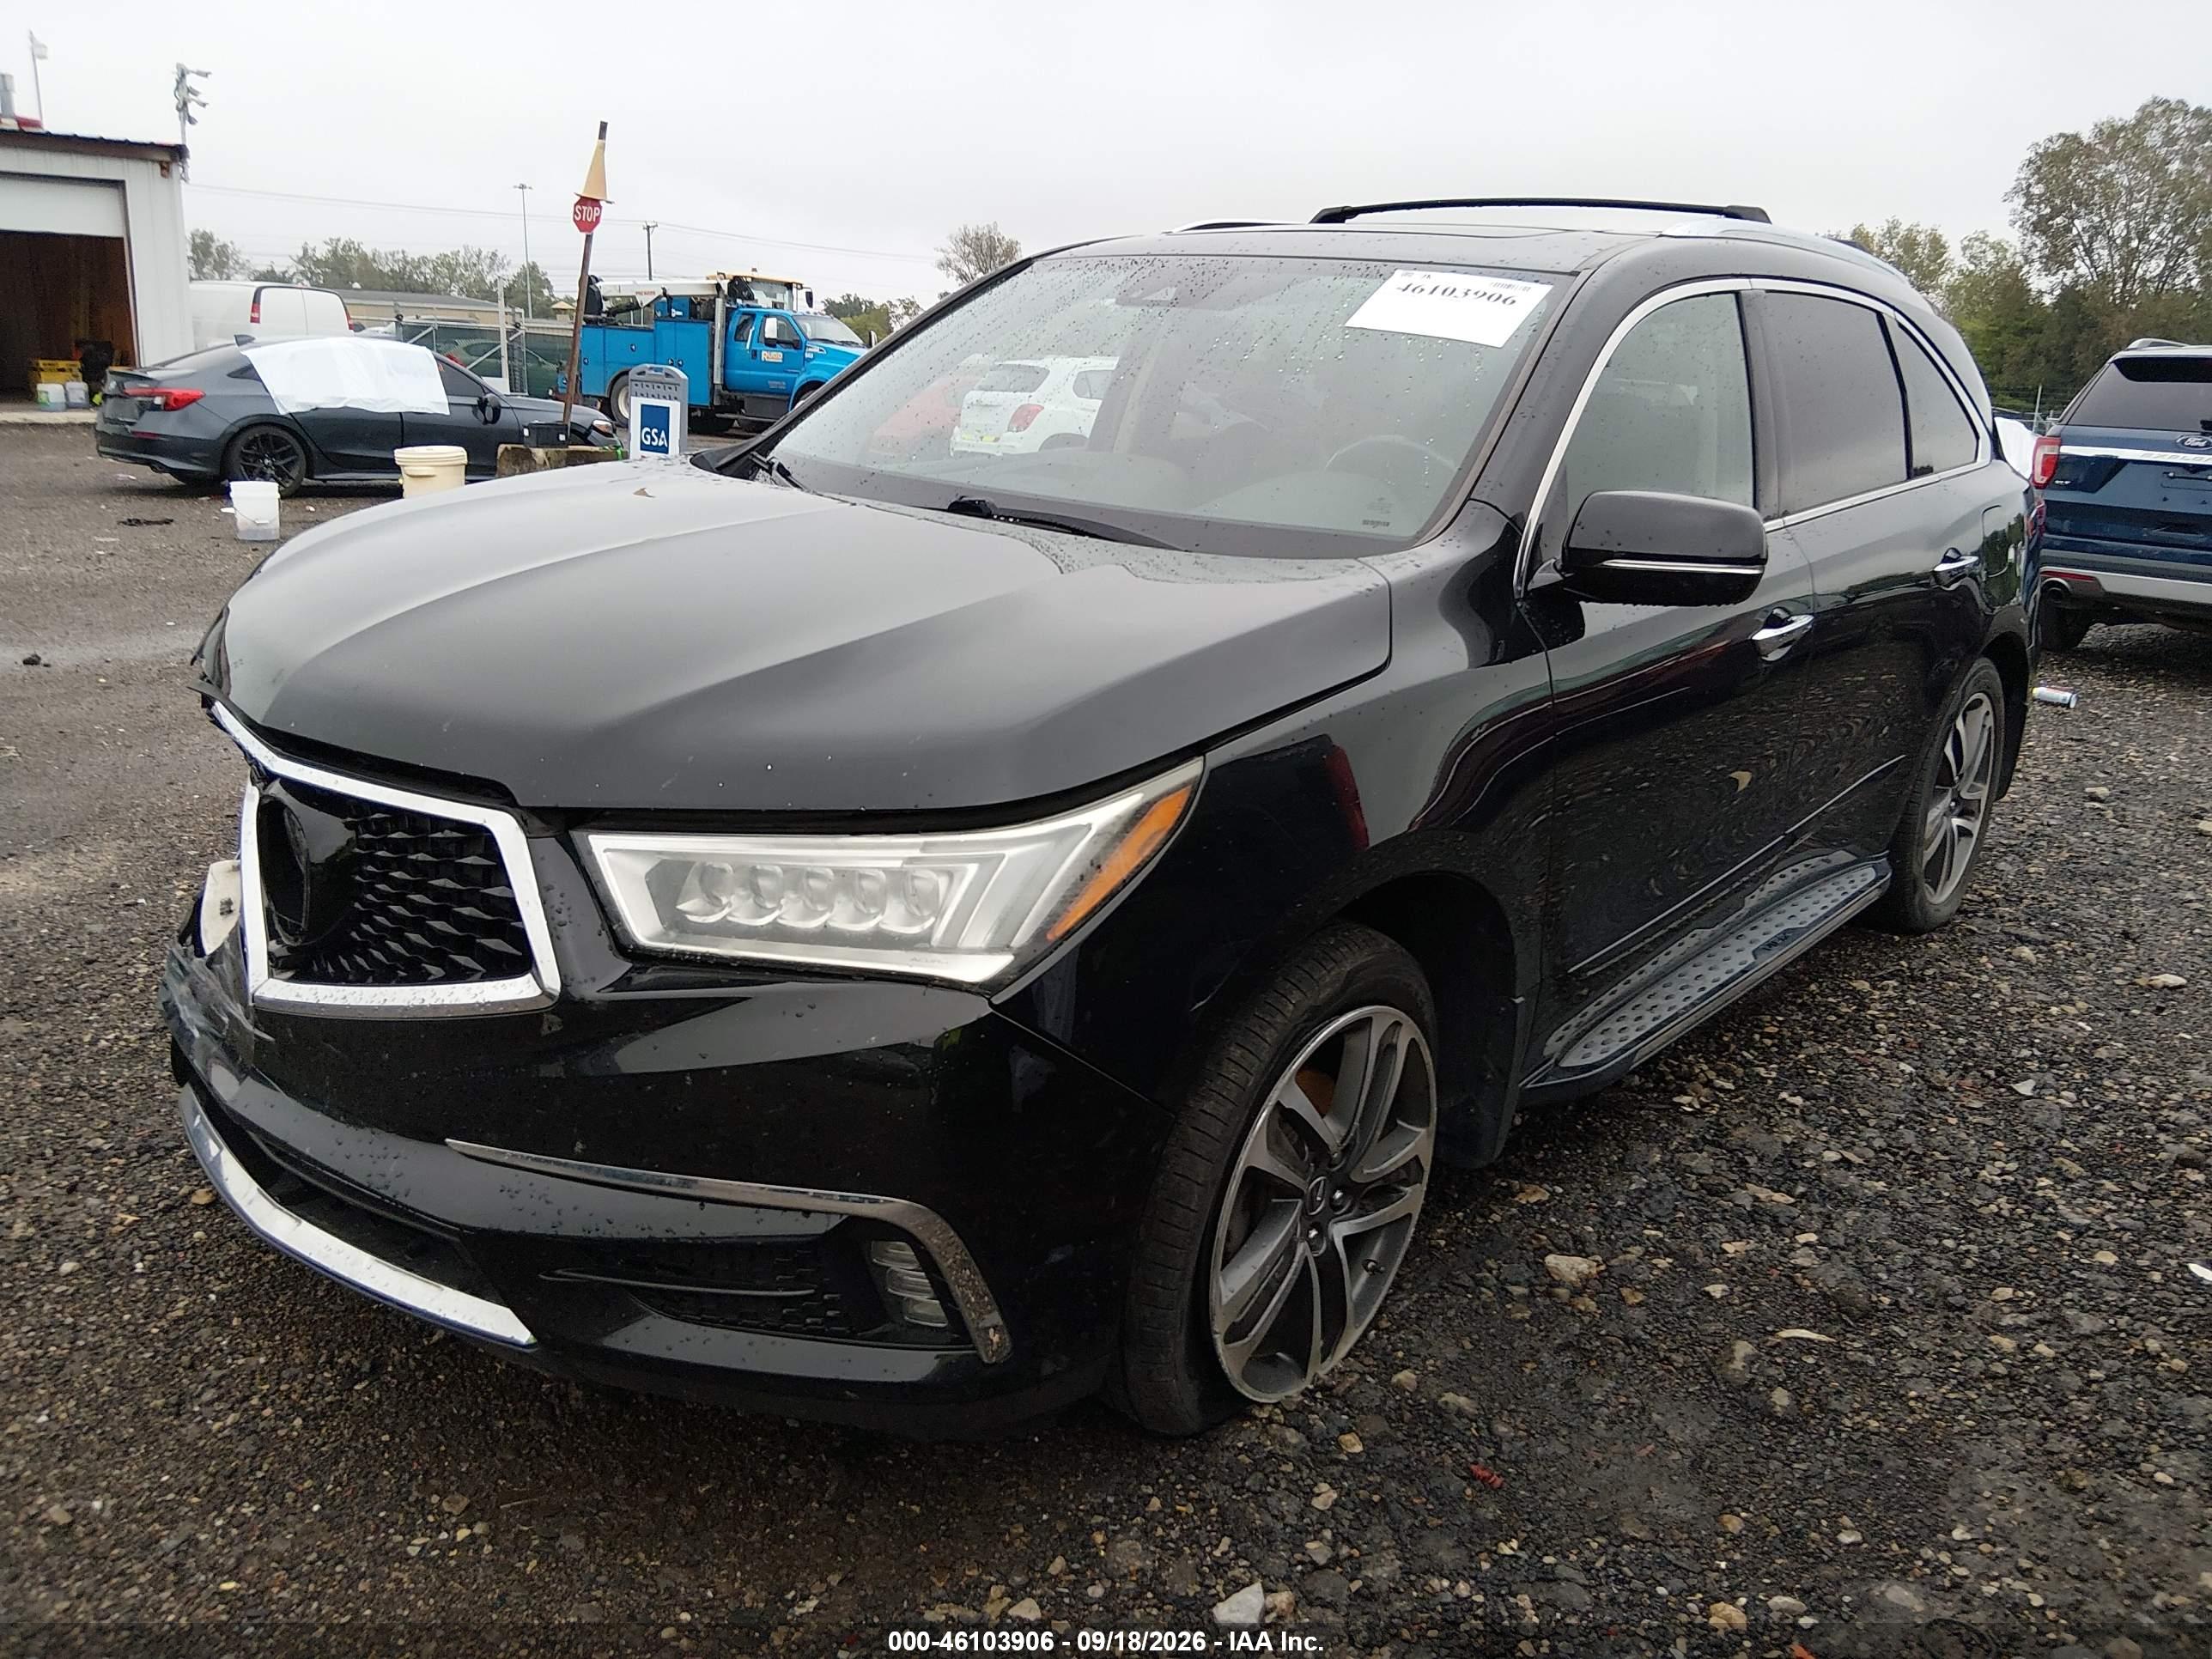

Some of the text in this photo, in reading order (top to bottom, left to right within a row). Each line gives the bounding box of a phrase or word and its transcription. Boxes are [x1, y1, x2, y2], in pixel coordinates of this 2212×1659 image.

[574, 204, 600, 222] STOP
[1395, 282, 1517, 306] 46103906
[641, 426, 668, 447] GSA
[2184, 436, 2208, 447] Ford
